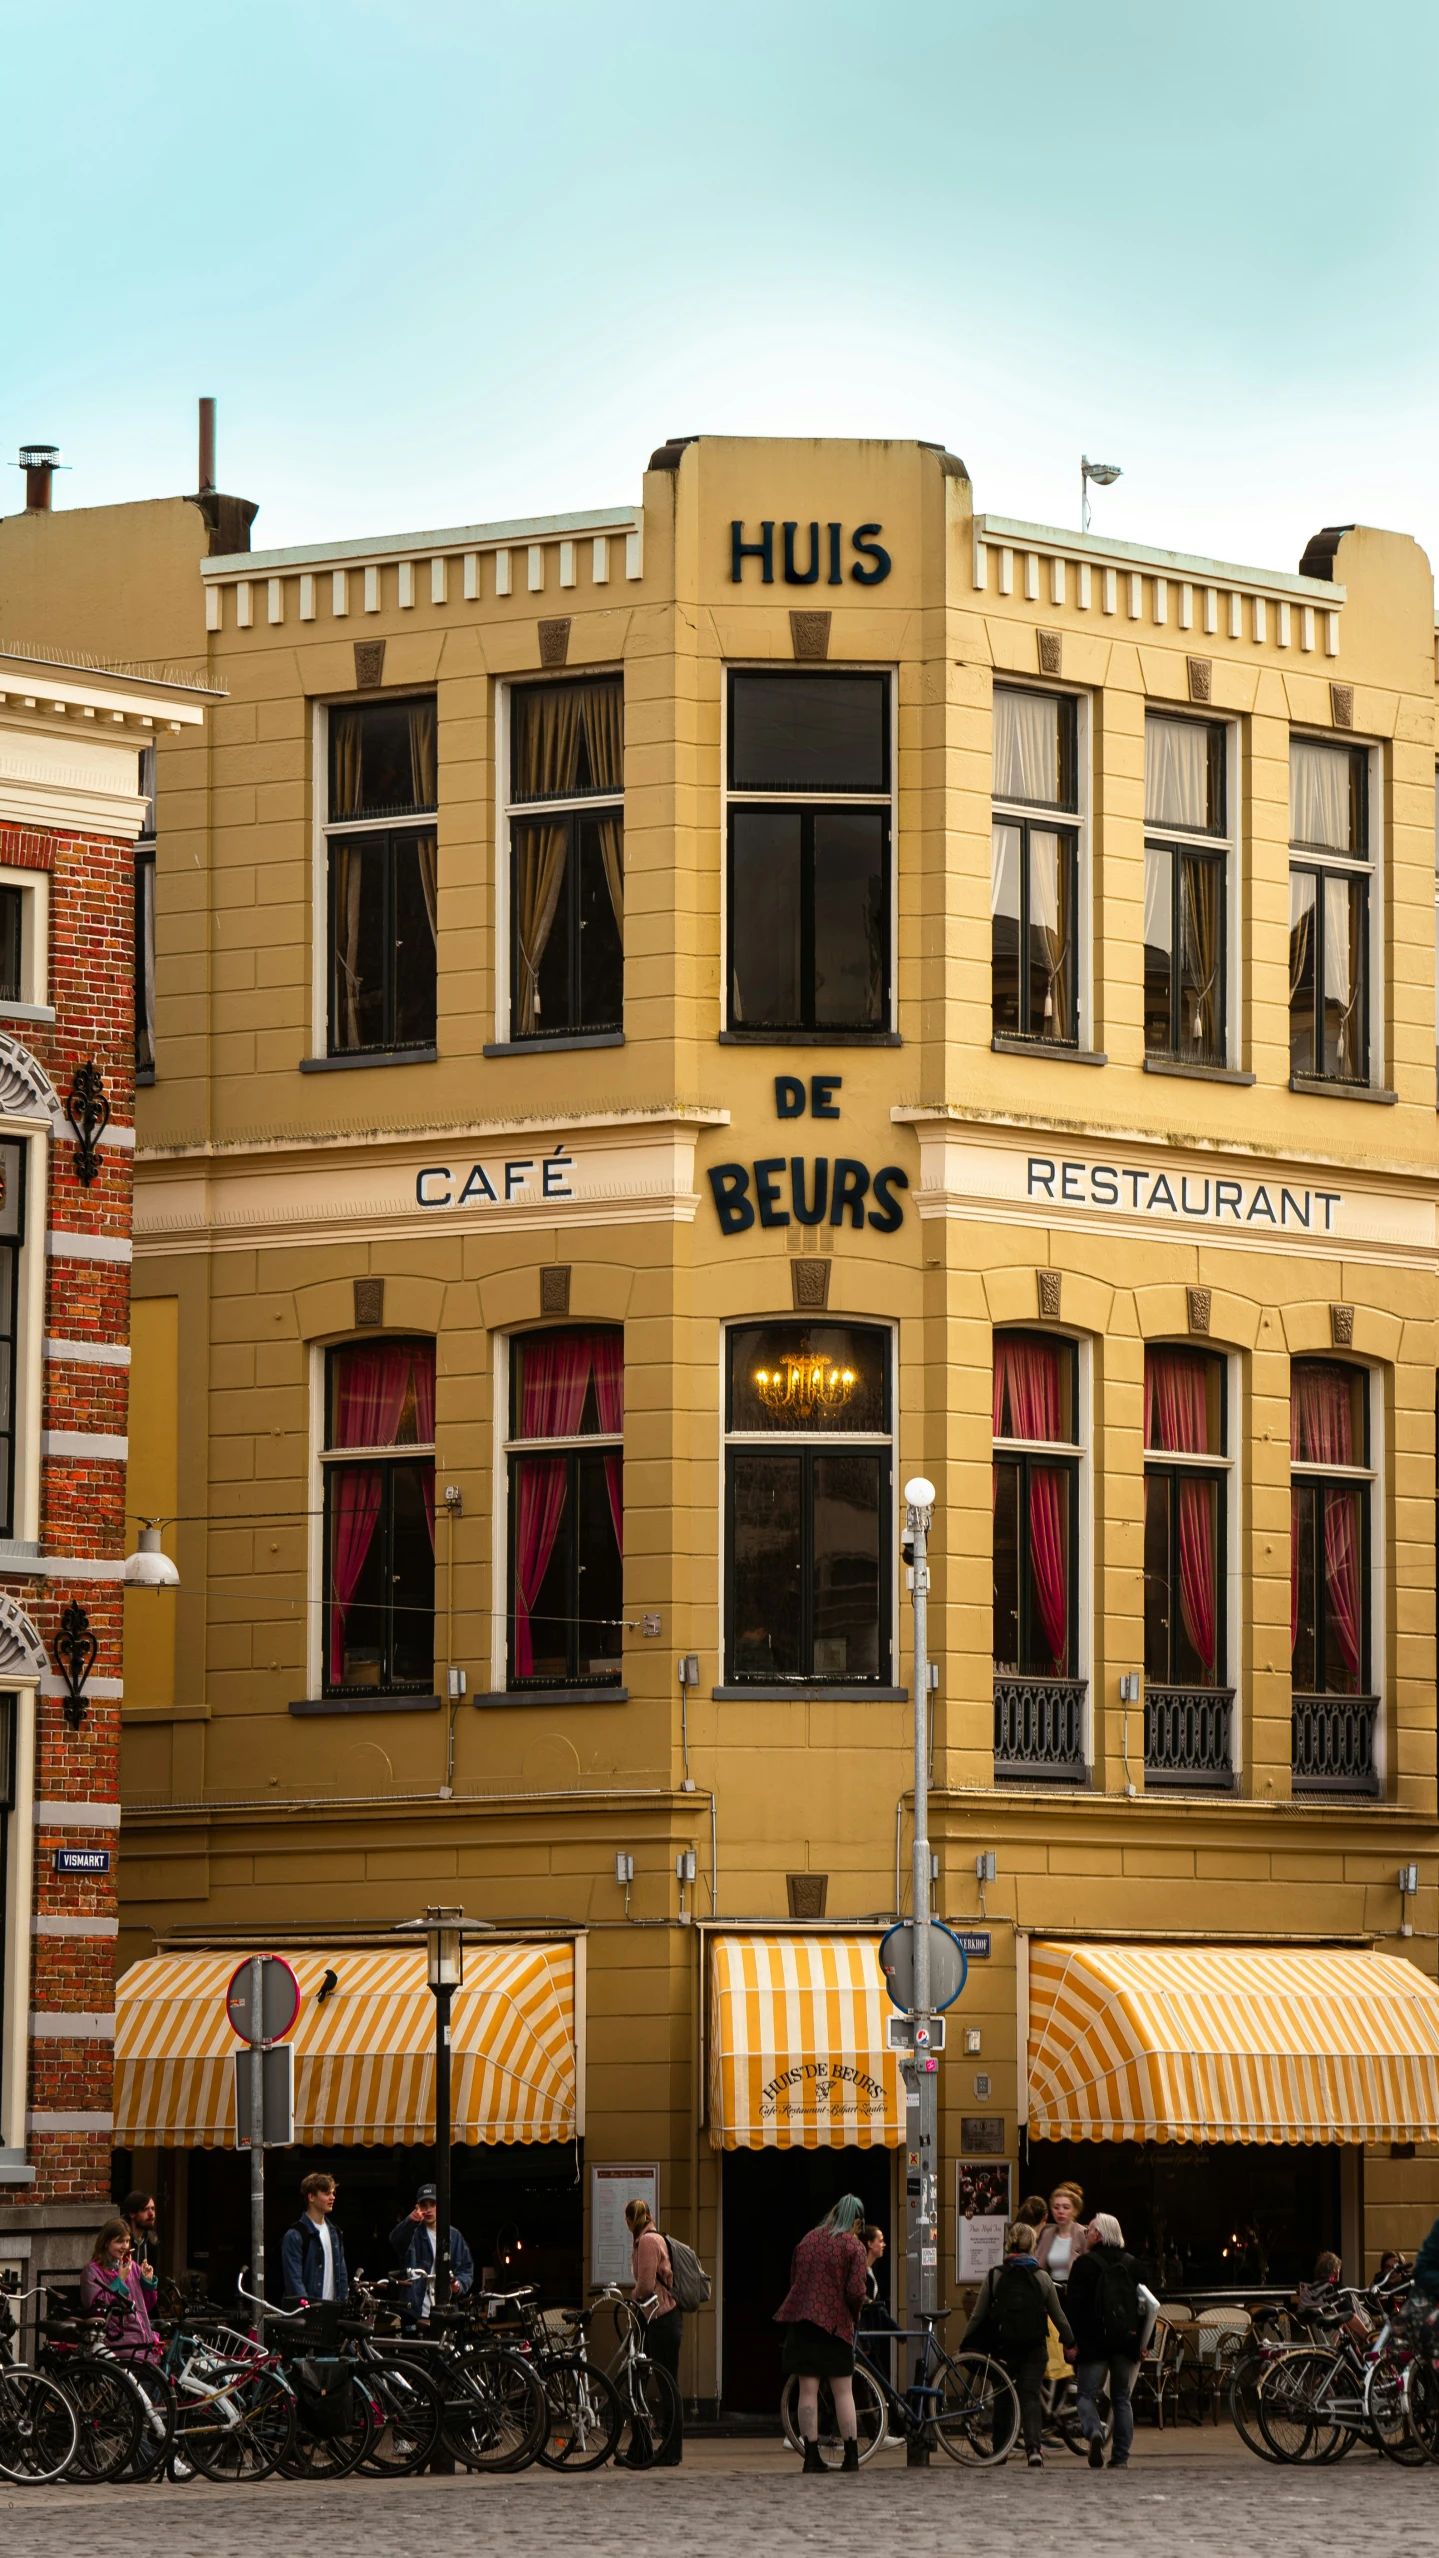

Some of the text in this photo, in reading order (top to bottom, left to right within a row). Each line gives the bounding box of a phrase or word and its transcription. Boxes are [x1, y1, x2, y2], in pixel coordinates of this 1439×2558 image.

[731, 520, 892, 585] HUIS
[774, 1075, 843, 1119] DE
[416, 1144, 573, 1207] CAFÉ
[707, 1156, 909, 1236] BEURS
[1027, 1157, 1342, 1230] RESTAURANT
[63, 1854, 105, 1867] VISMARKT
